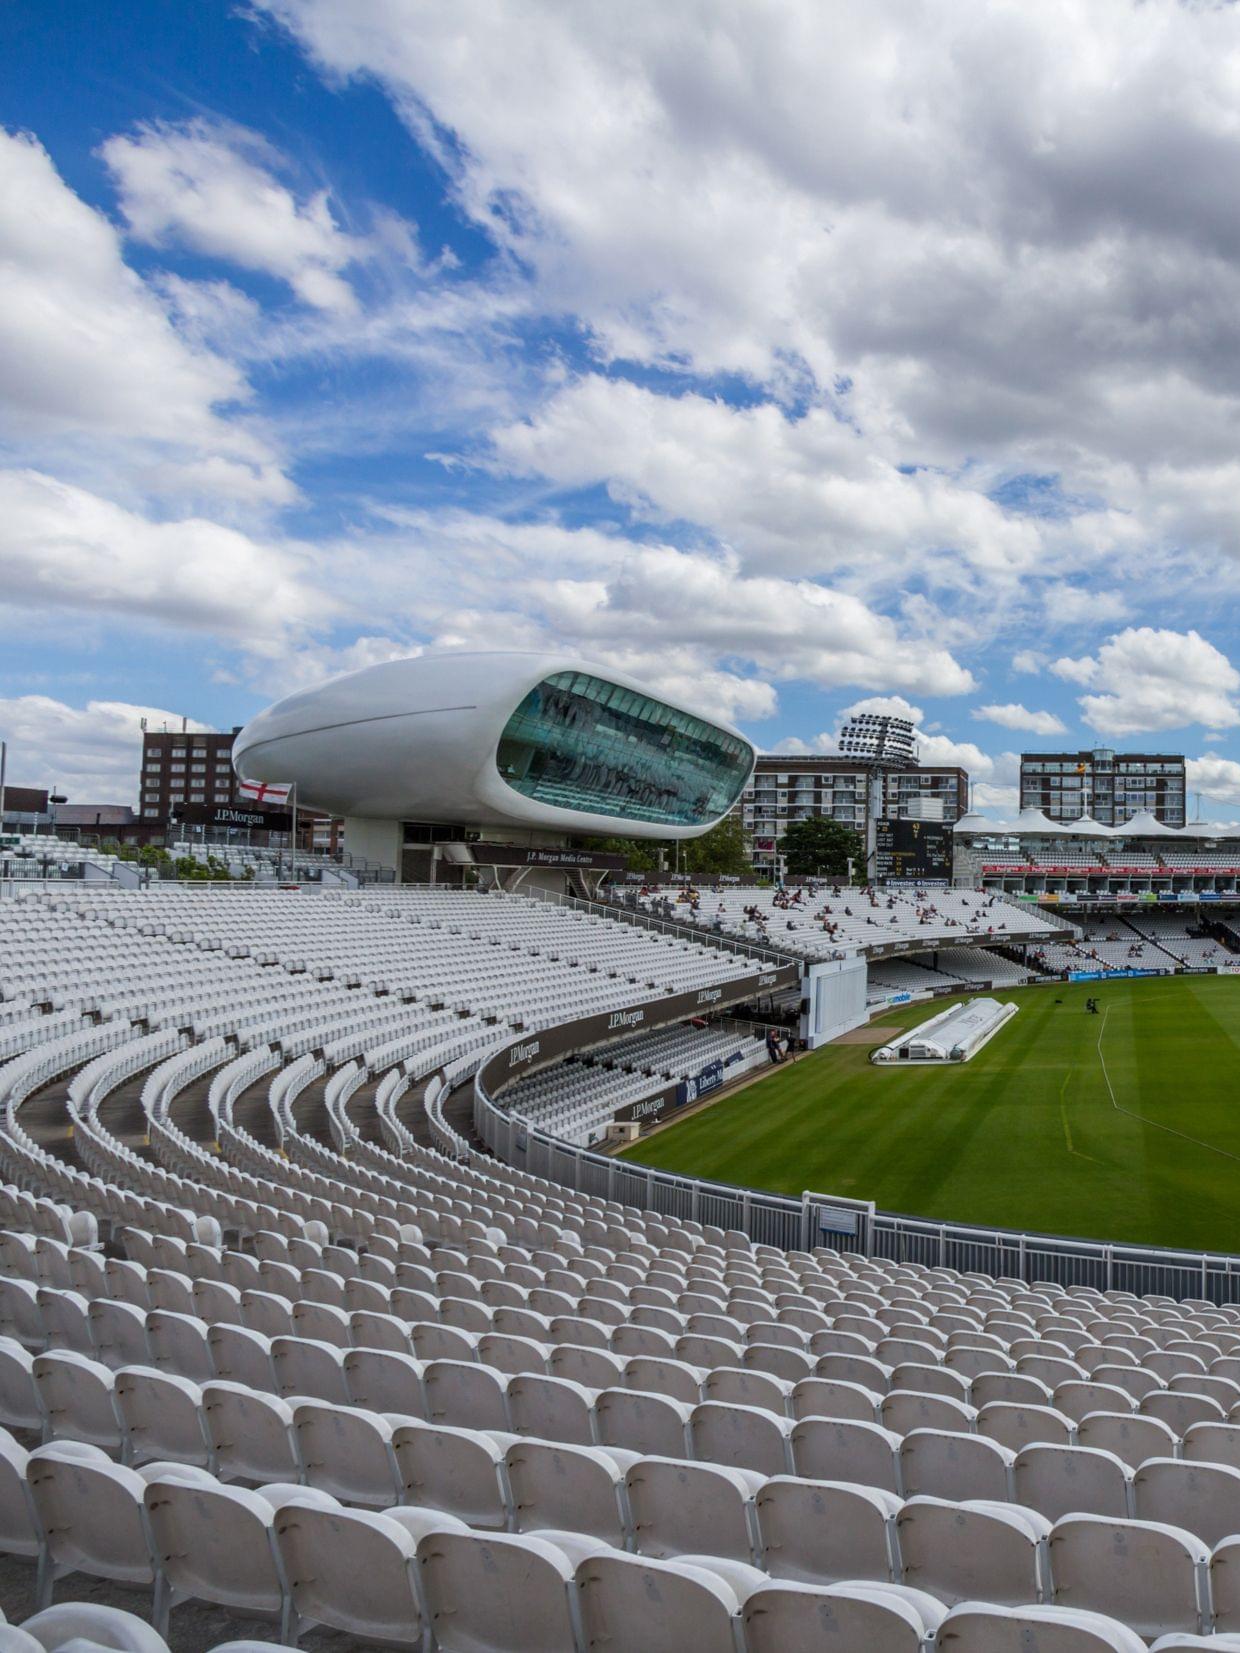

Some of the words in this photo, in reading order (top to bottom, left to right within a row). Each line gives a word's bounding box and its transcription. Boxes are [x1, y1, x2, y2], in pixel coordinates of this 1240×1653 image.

[214, 809, 264, 826] J.P.Morgan
[538, 852, 559, 863] Morgan
[608, 1008, 644, 1029] J.P.Morgan
[509, 1040, 540, 1067] J.P.Morgan
[631, 1097, 665, 1121] J.P.Morgan
